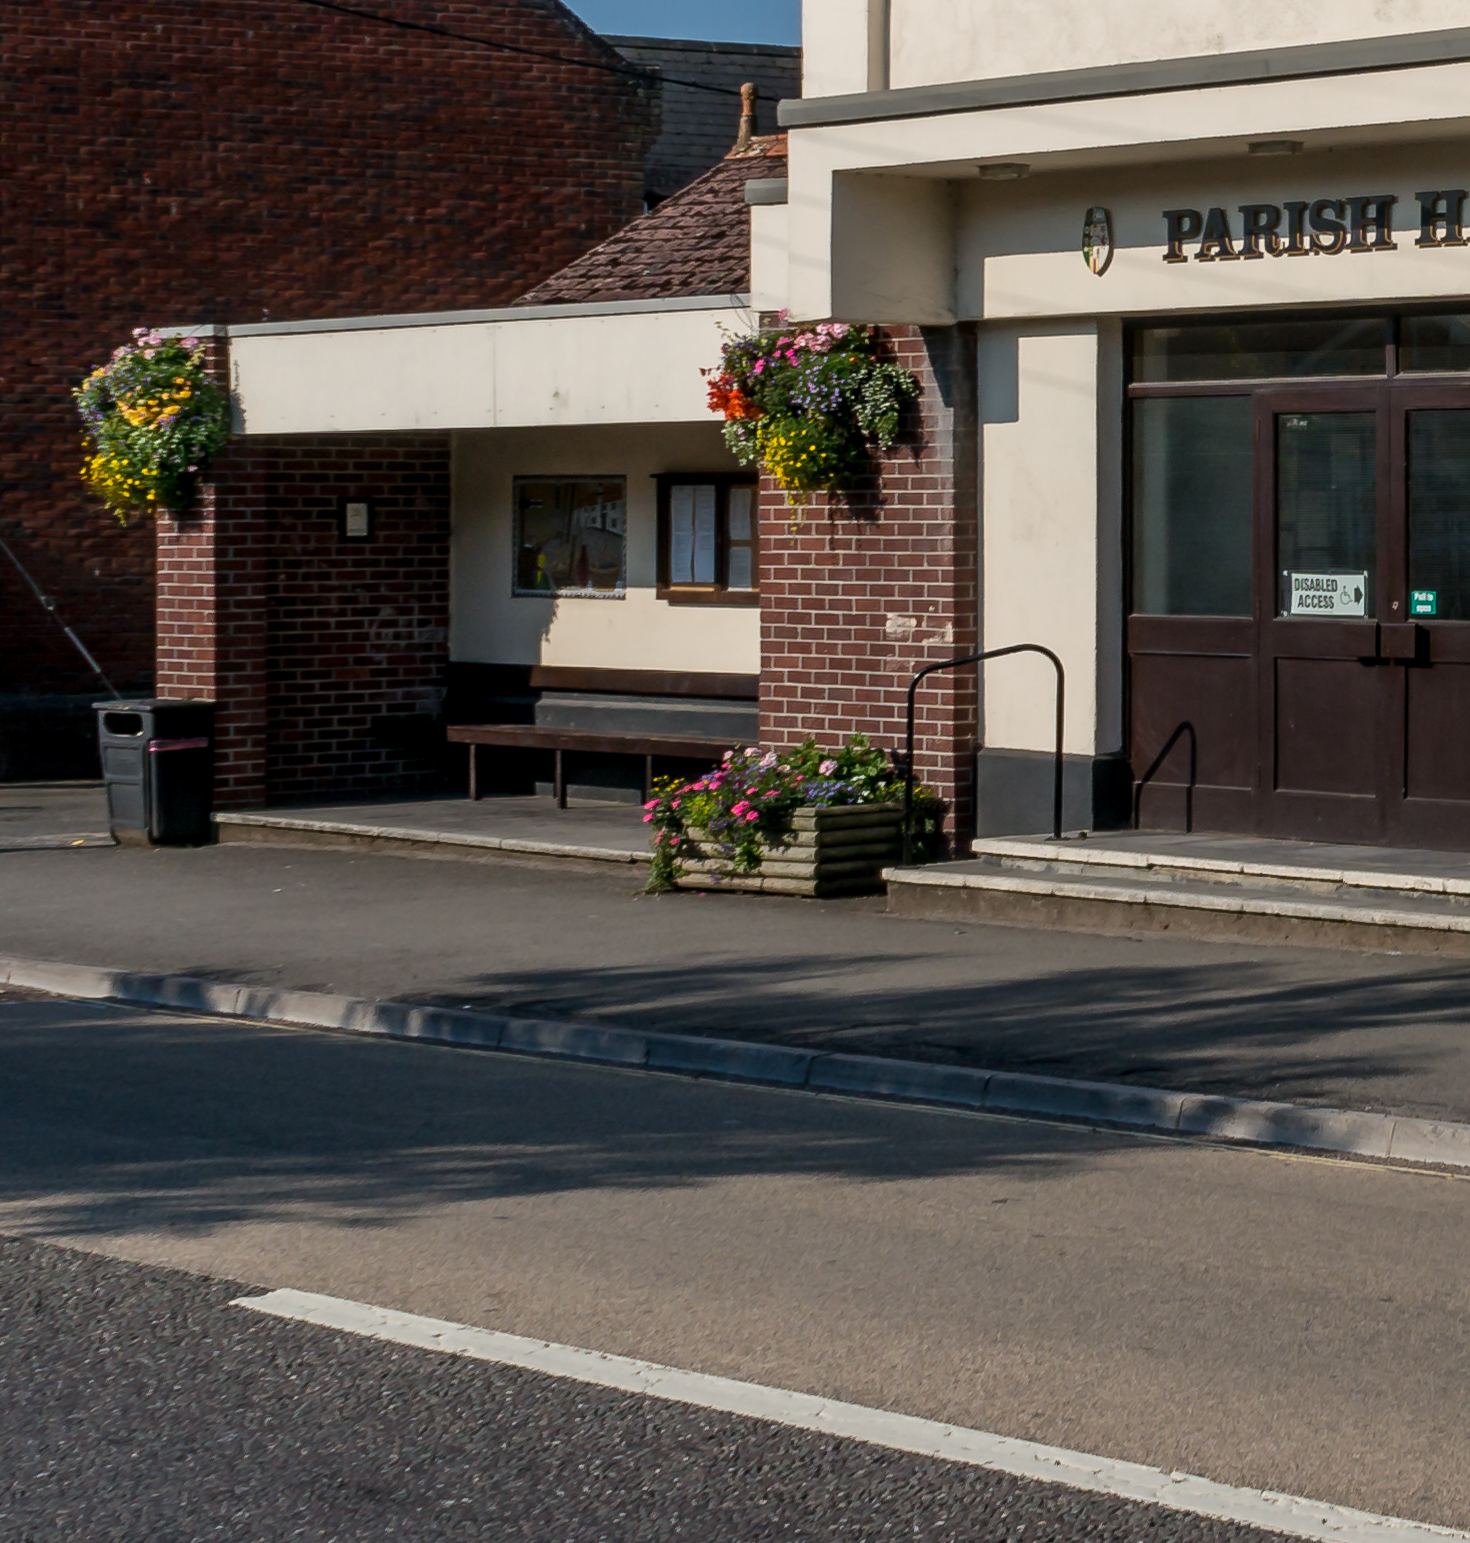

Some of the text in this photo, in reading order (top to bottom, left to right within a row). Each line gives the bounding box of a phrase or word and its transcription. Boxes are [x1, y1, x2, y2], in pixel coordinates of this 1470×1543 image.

[1161, 194, 1399, 264] PARISH
[1294, 577, 1338, 592] DISABLED
[1297, 594, 1335, 609] ACCESS
